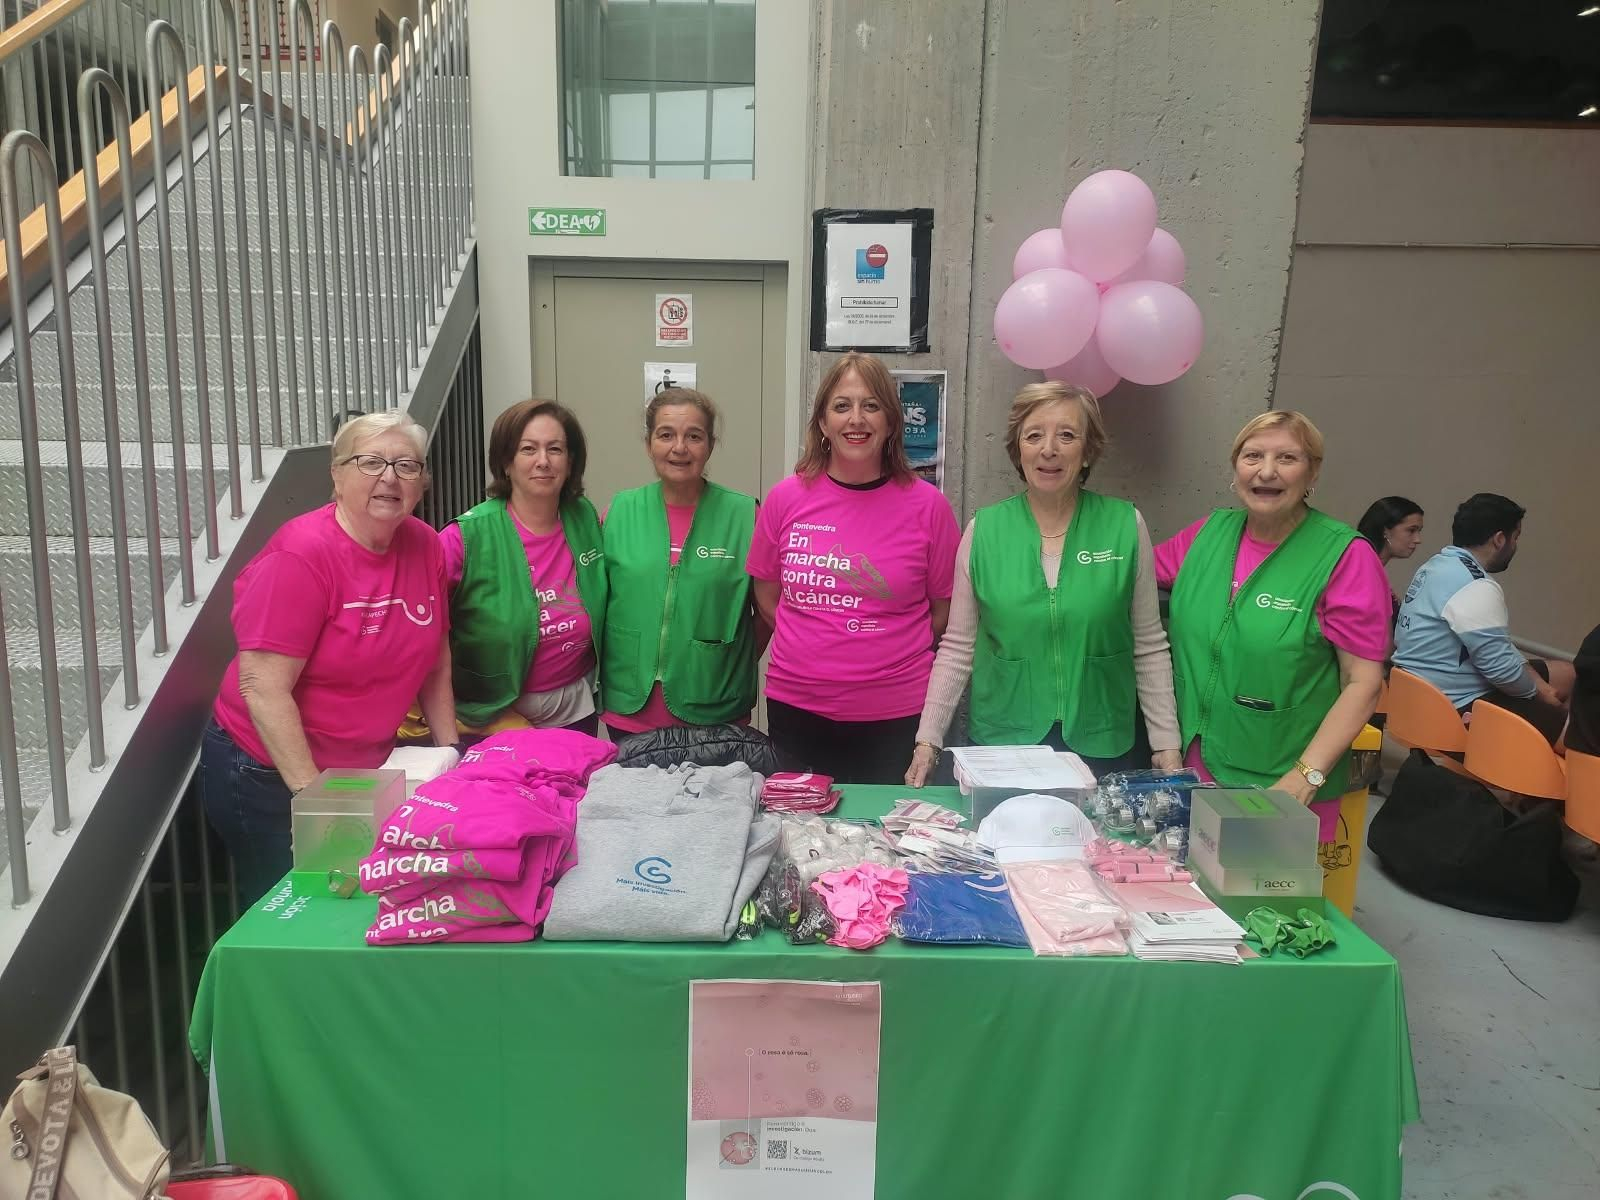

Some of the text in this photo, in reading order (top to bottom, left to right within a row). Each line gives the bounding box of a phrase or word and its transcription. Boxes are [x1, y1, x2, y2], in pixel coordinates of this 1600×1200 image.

[546, 214, 581, 229] DEA
[792, 522, 836, 532] Pontevedra
[788, 532, 809, 548] En
[784, 552, 851, 571] marcha
[782, 569, 836, 588] contra
[795, 588, 863, 609] cáncer
[540, 619, 577, 637] ncer
[383, 825, 446, 850] arch
[1264, 880, 1296, 888] aecc
[378, 895, 457, 931] archa
